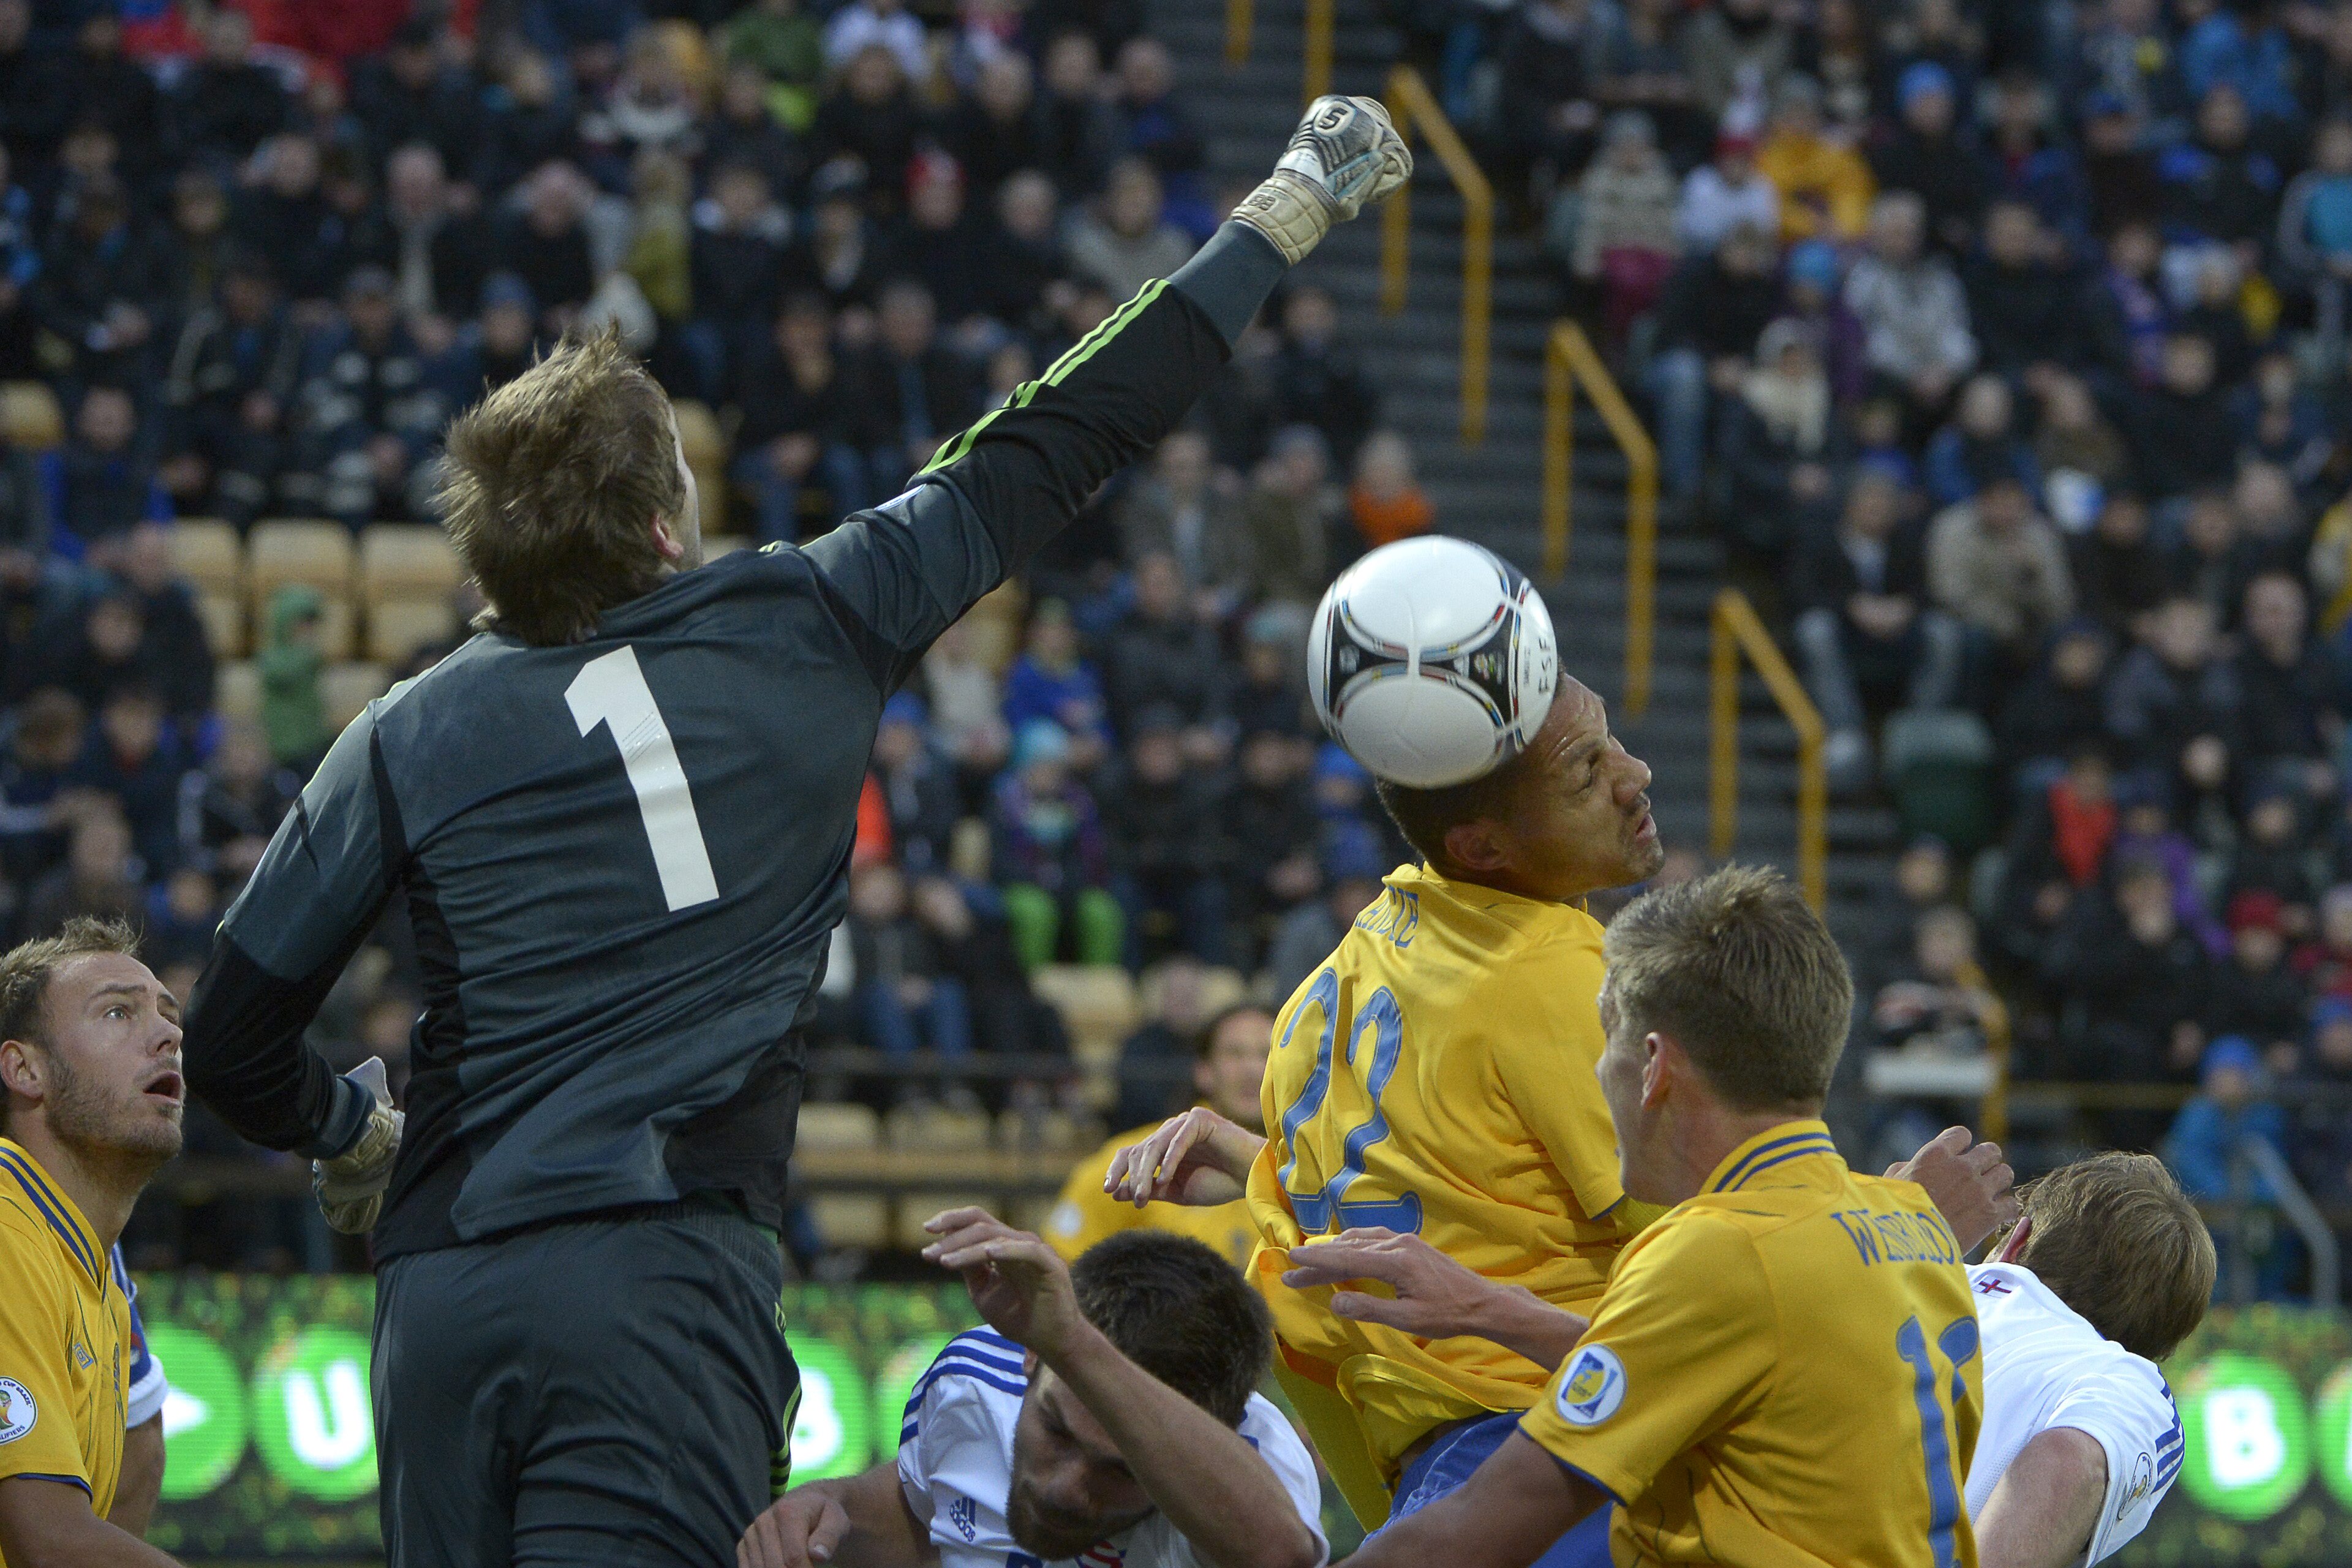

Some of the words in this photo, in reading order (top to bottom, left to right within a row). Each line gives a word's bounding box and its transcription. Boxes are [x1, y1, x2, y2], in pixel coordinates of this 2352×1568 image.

[564, 644, 720, 912] 1
[1279, 967, 1423, 1236] 22
[949, 1499, 976, 1542] adidas
[2203, 1384, 2285, 1491] B
